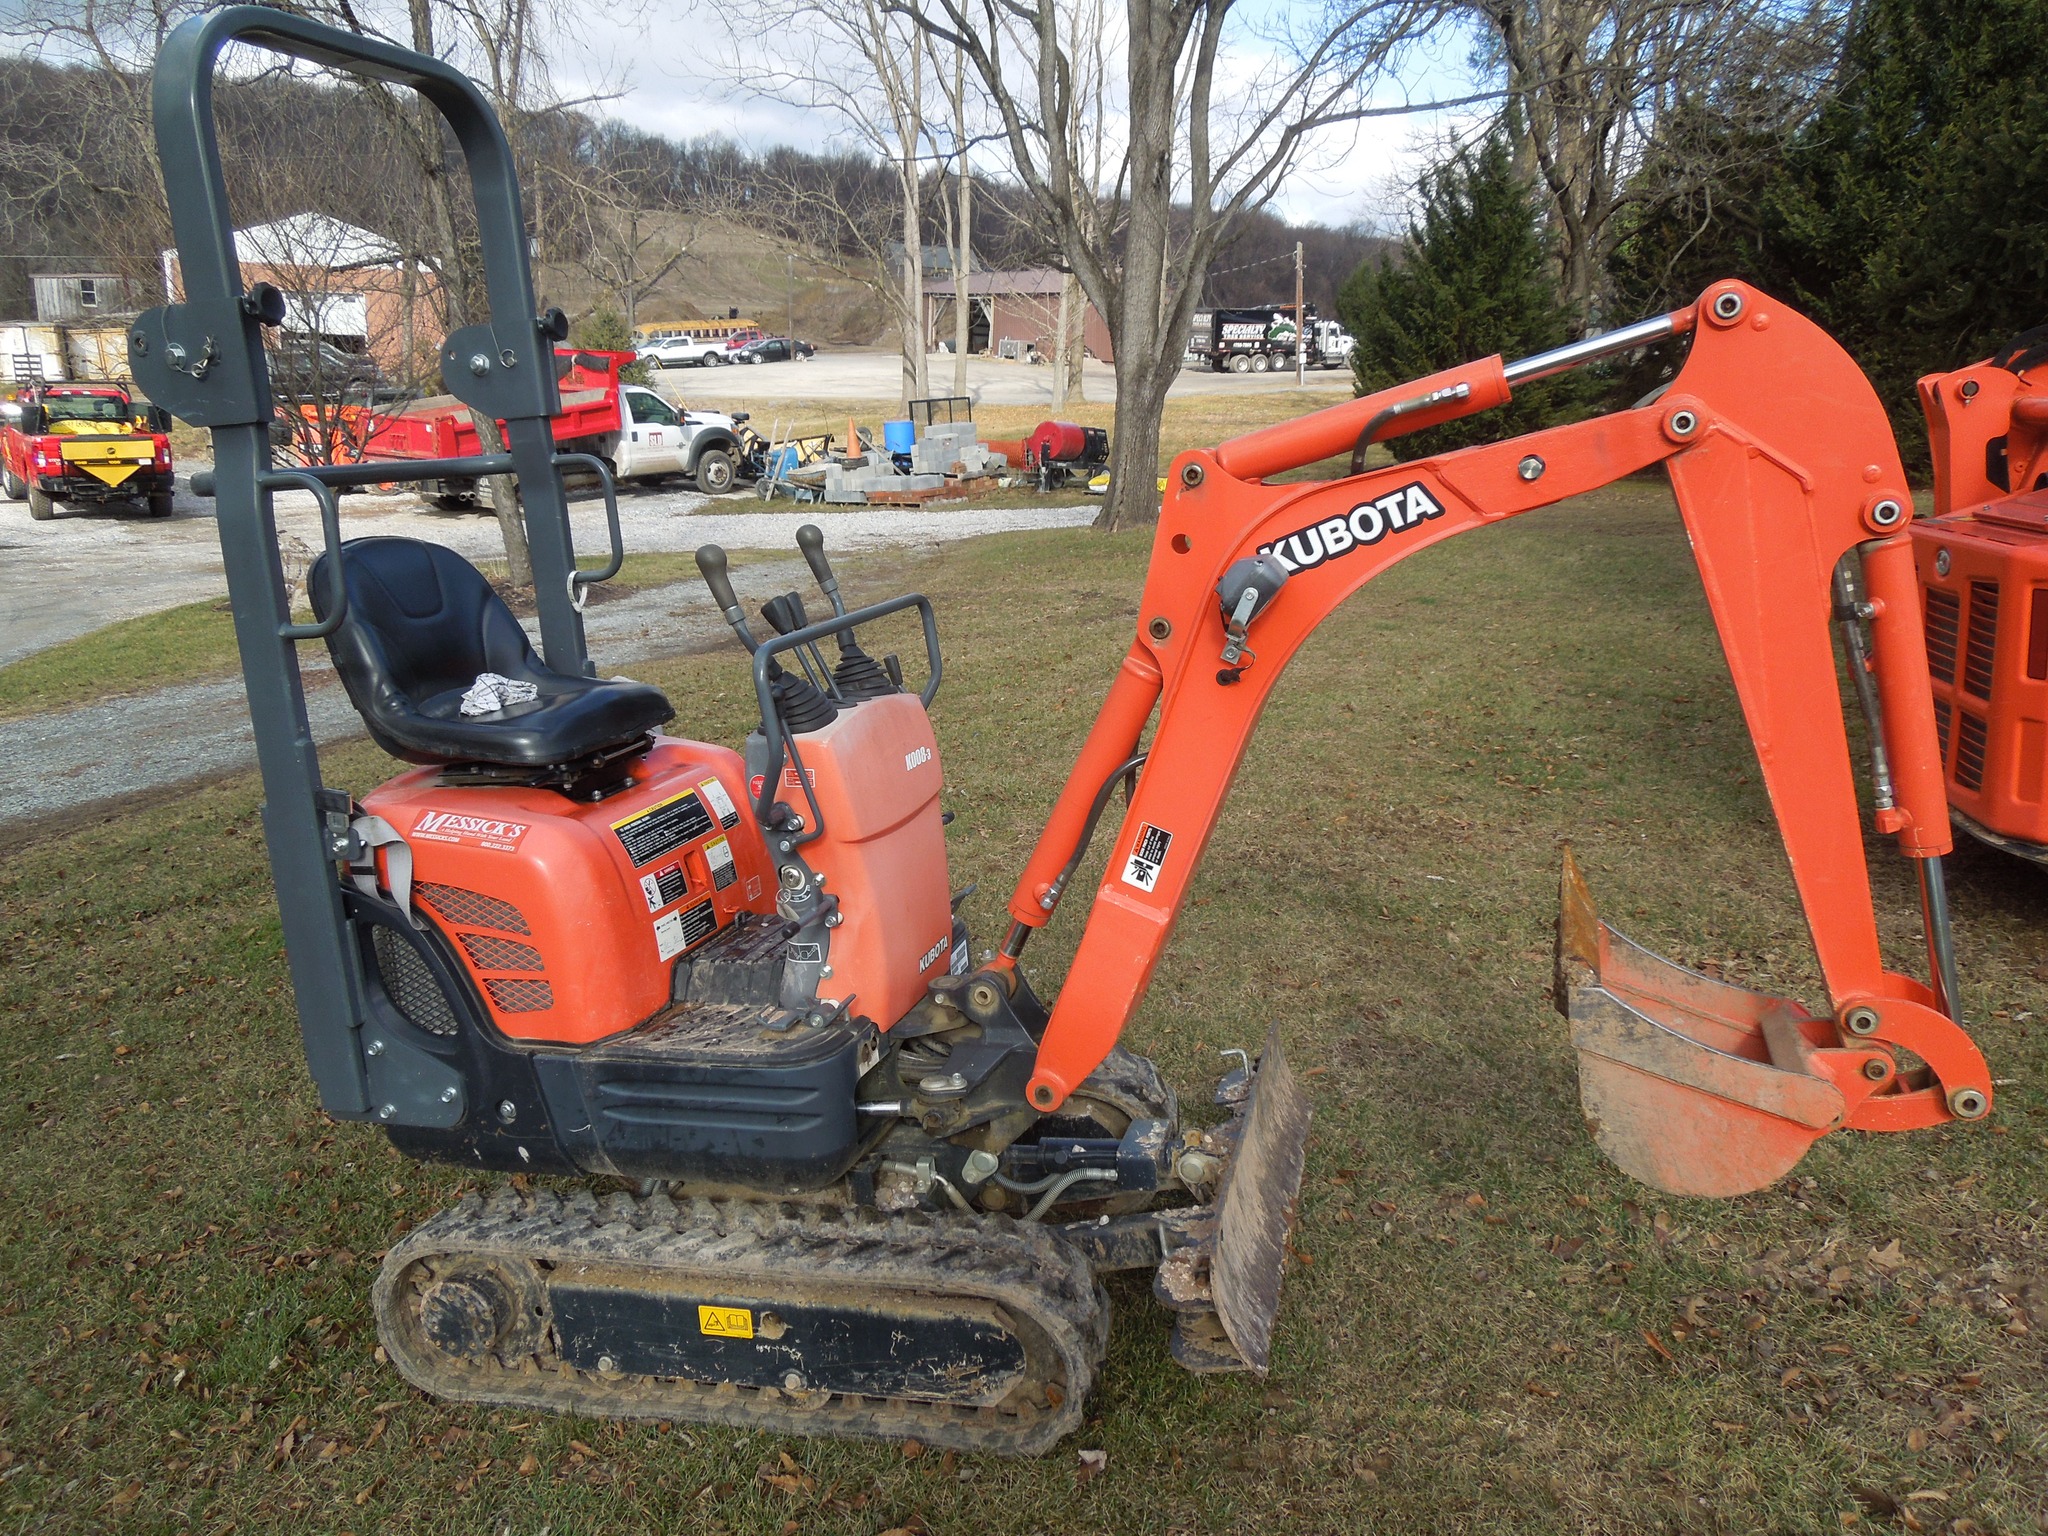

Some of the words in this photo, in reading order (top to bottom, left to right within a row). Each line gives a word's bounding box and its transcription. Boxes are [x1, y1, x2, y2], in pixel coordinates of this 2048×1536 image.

[1222, 323, 1266, 335] SPECIALTY
[1260, 485, 1439, 572] KUBOTA
[904, 746, 932, 772] K008-3
[414, 811, 527, 838] MESSICK'S
[919, 935, 949, 974] KUBOTA
